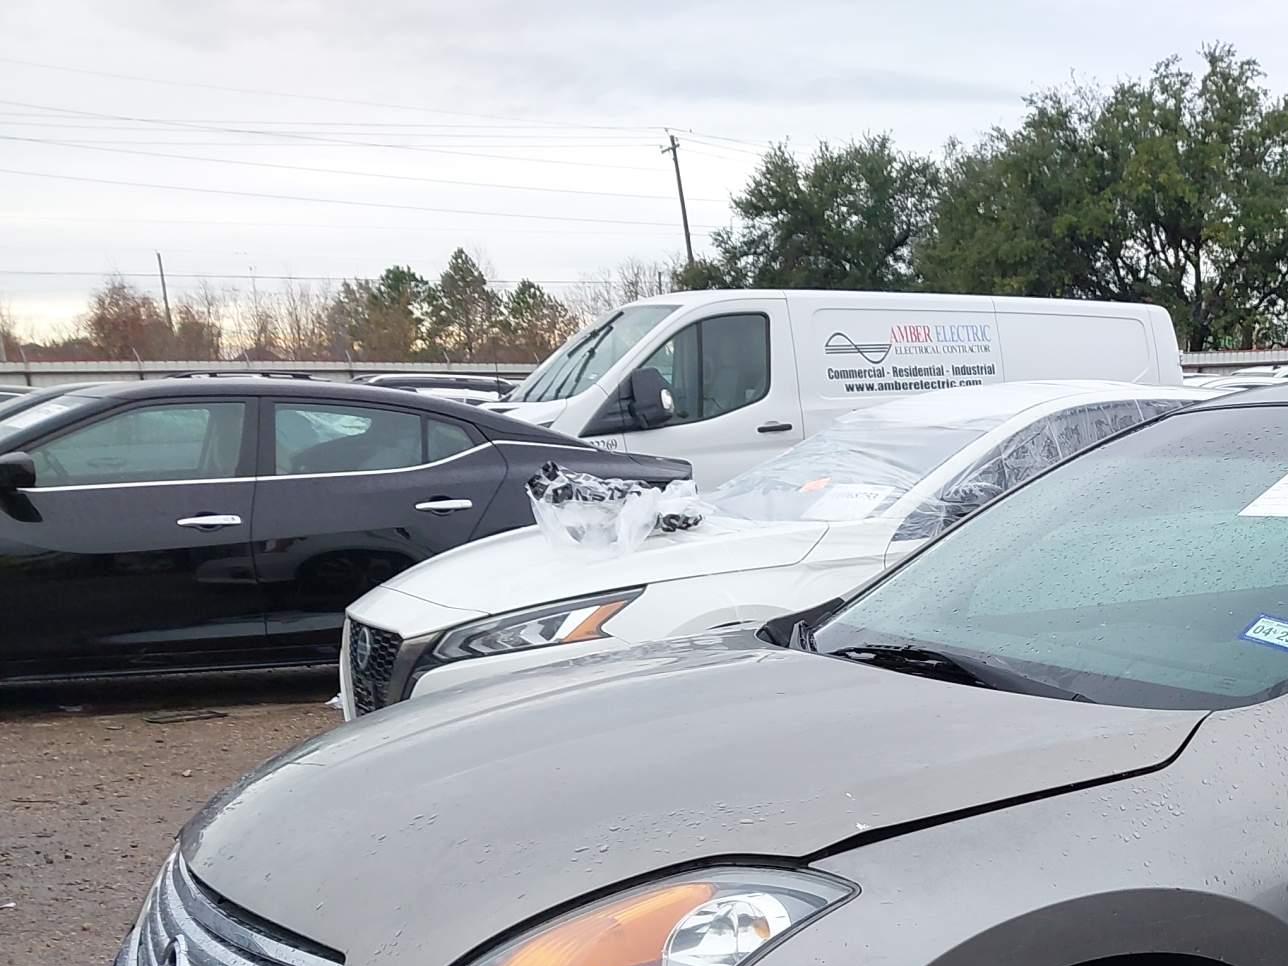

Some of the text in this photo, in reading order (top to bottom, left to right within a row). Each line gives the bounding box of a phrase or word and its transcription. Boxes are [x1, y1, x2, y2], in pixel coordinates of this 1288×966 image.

[890, 324, 991, 342] AMBER ELECTRIC
[895, 344, 991, 355] ELECTRICAL CONTRACTOR
[827, 367, 885, 380] Commercial
[892, 365, 945, 378] Residential
[952, 363, 996, 376] Industrial
